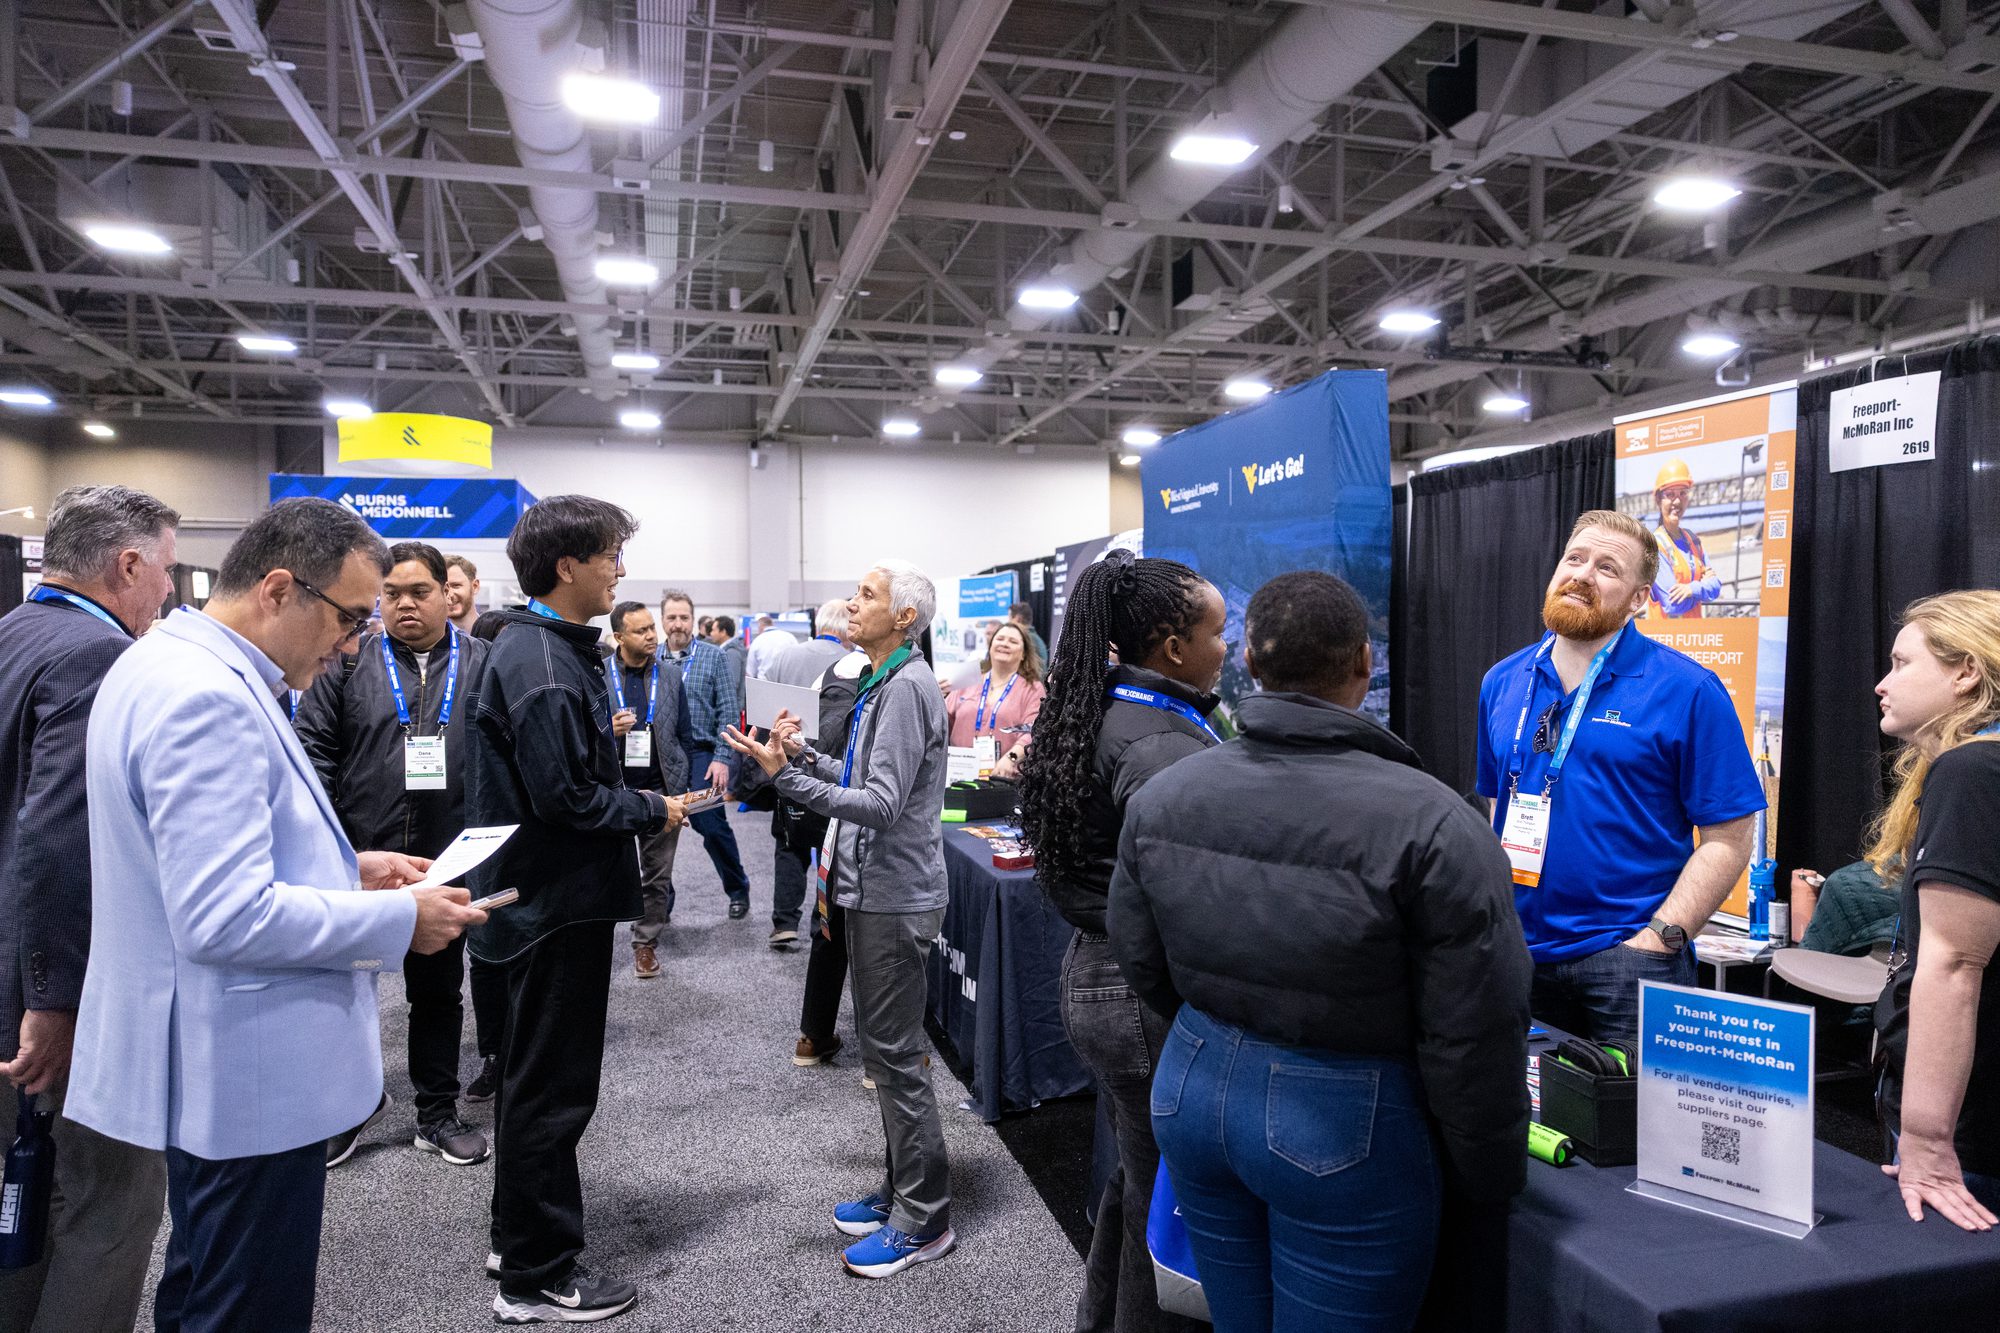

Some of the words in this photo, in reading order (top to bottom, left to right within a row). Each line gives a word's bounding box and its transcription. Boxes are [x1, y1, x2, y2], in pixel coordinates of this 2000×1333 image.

[1853, 399, 1901, 418] Freeport-
[1843, 421, 1890, 439] McMoRan
[1893, 417, 1914, 431] Inc
[1902, 440, 1930, 455] 2619
[1258, 461, 1284, 486] Let's
[1285, 453, 1305, 478] Go!
[355, 494, 407, 506] BURNS
[1676, 633, 1724, 646] FUTURE
[1682, 651, 1744, 665] REEPORT
[1674, 1004, 1717, 1022] Thank
[1721, 1014, 1748, 1028] you
[1753, 1018, 1776, 1033] for
[1668, 1021, 1701, 1035] your
[1704, 1027, 1762, 1048] interest
[1766, 1038, 1781, 1051] in
[1655, 1034, 1795, 1072] Freeport-McMoRan
[1654, 1068, 1674, 1080] For
[1676, 1072, 1689, 1084] all
[1693, 1078, 1735, 1094] vendor
[1737, 1085, 1795, 1108] inquiries,
[1678, 1088, 1715, 1103] please
[1718, 1096, 1743, 1110] visit
[1746, 1104, 1768, 1115] our
[1677, 1102, 1730, 1120] suppliers
[1733, 1114, 1767, 1129] page.
